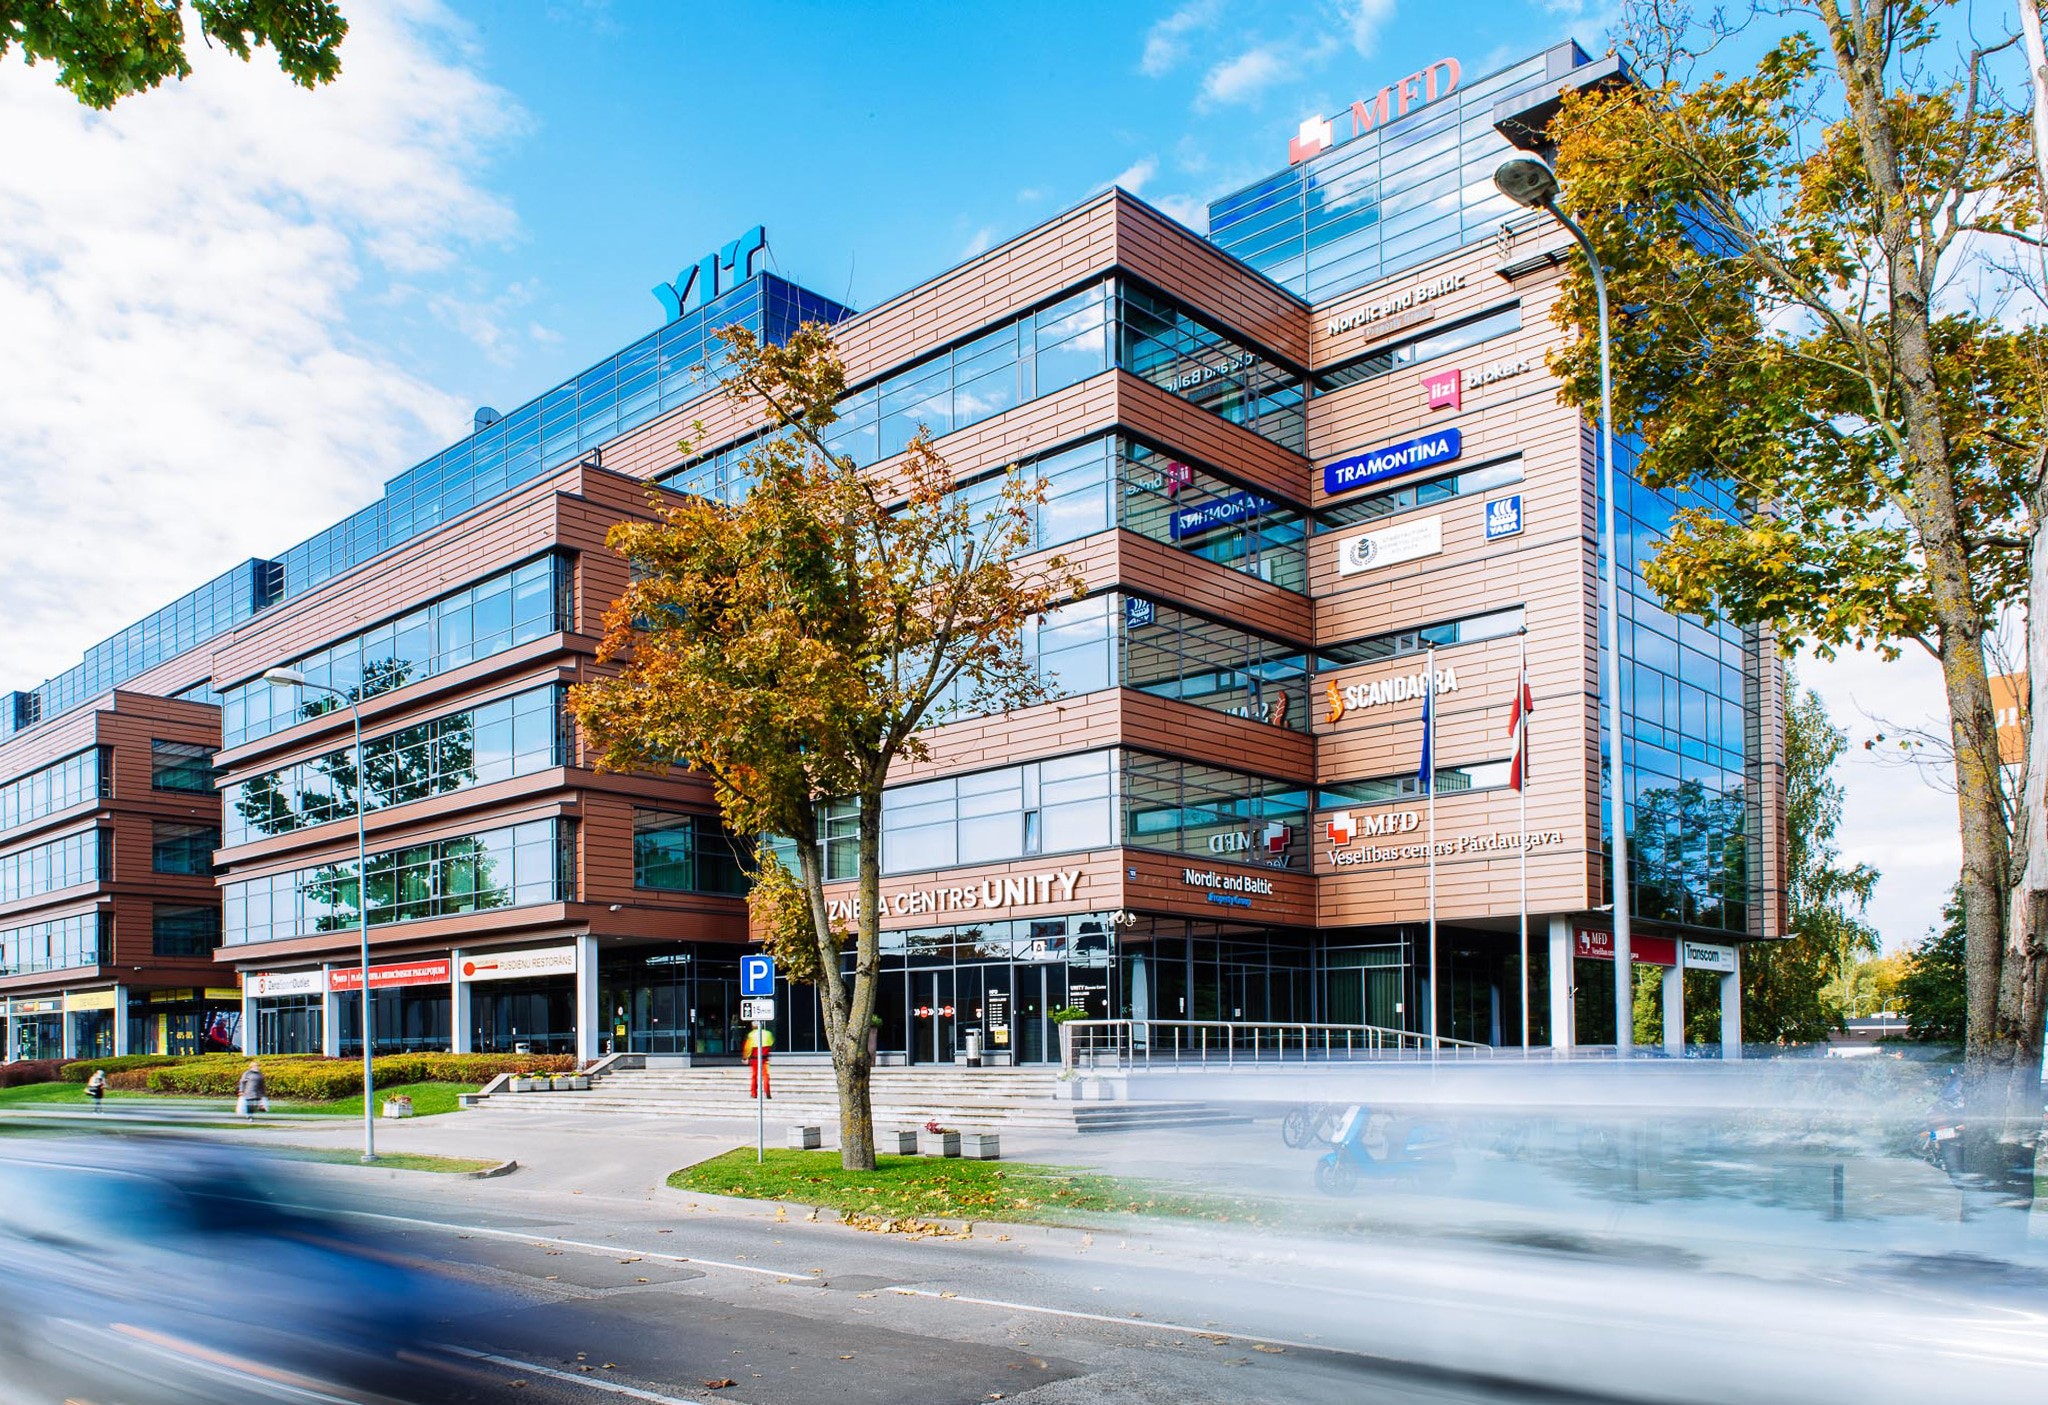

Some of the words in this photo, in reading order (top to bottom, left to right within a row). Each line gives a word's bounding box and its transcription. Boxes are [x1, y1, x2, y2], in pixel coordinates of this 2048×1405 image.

[1350, 57, 1461, 137] MFD
[652, 224, 765, 325] YIT
[1327, 304, 1380, 335] Nordic
[1381, 290, 1413, 314] and
[1415, 273, 1467, 302] Baltic
[1430, 377, 1457, 400] iizi
[1466, 357, 1531, 389] brokers
[1335, 438, 1450, 484] TRAMONTINA
[1490, 521, 1518, 536] YARA
[1364, 811, 1420, 836] MFD
[1327, 844, 1399, 866] Veselības
[895, 885, 979, 915] CENTRS
[982, 870, 1082, 909] UNITY
[1185, 868, 1221, 888] Nordic
[1223, 876, 1242, 891] and
[1244, 876, 1273, 895] Baltic
[1591, 931, 1607, 945] MFD
[1685, 943, 1720, 962] Transcom
[749, 960, 769, 993] P
